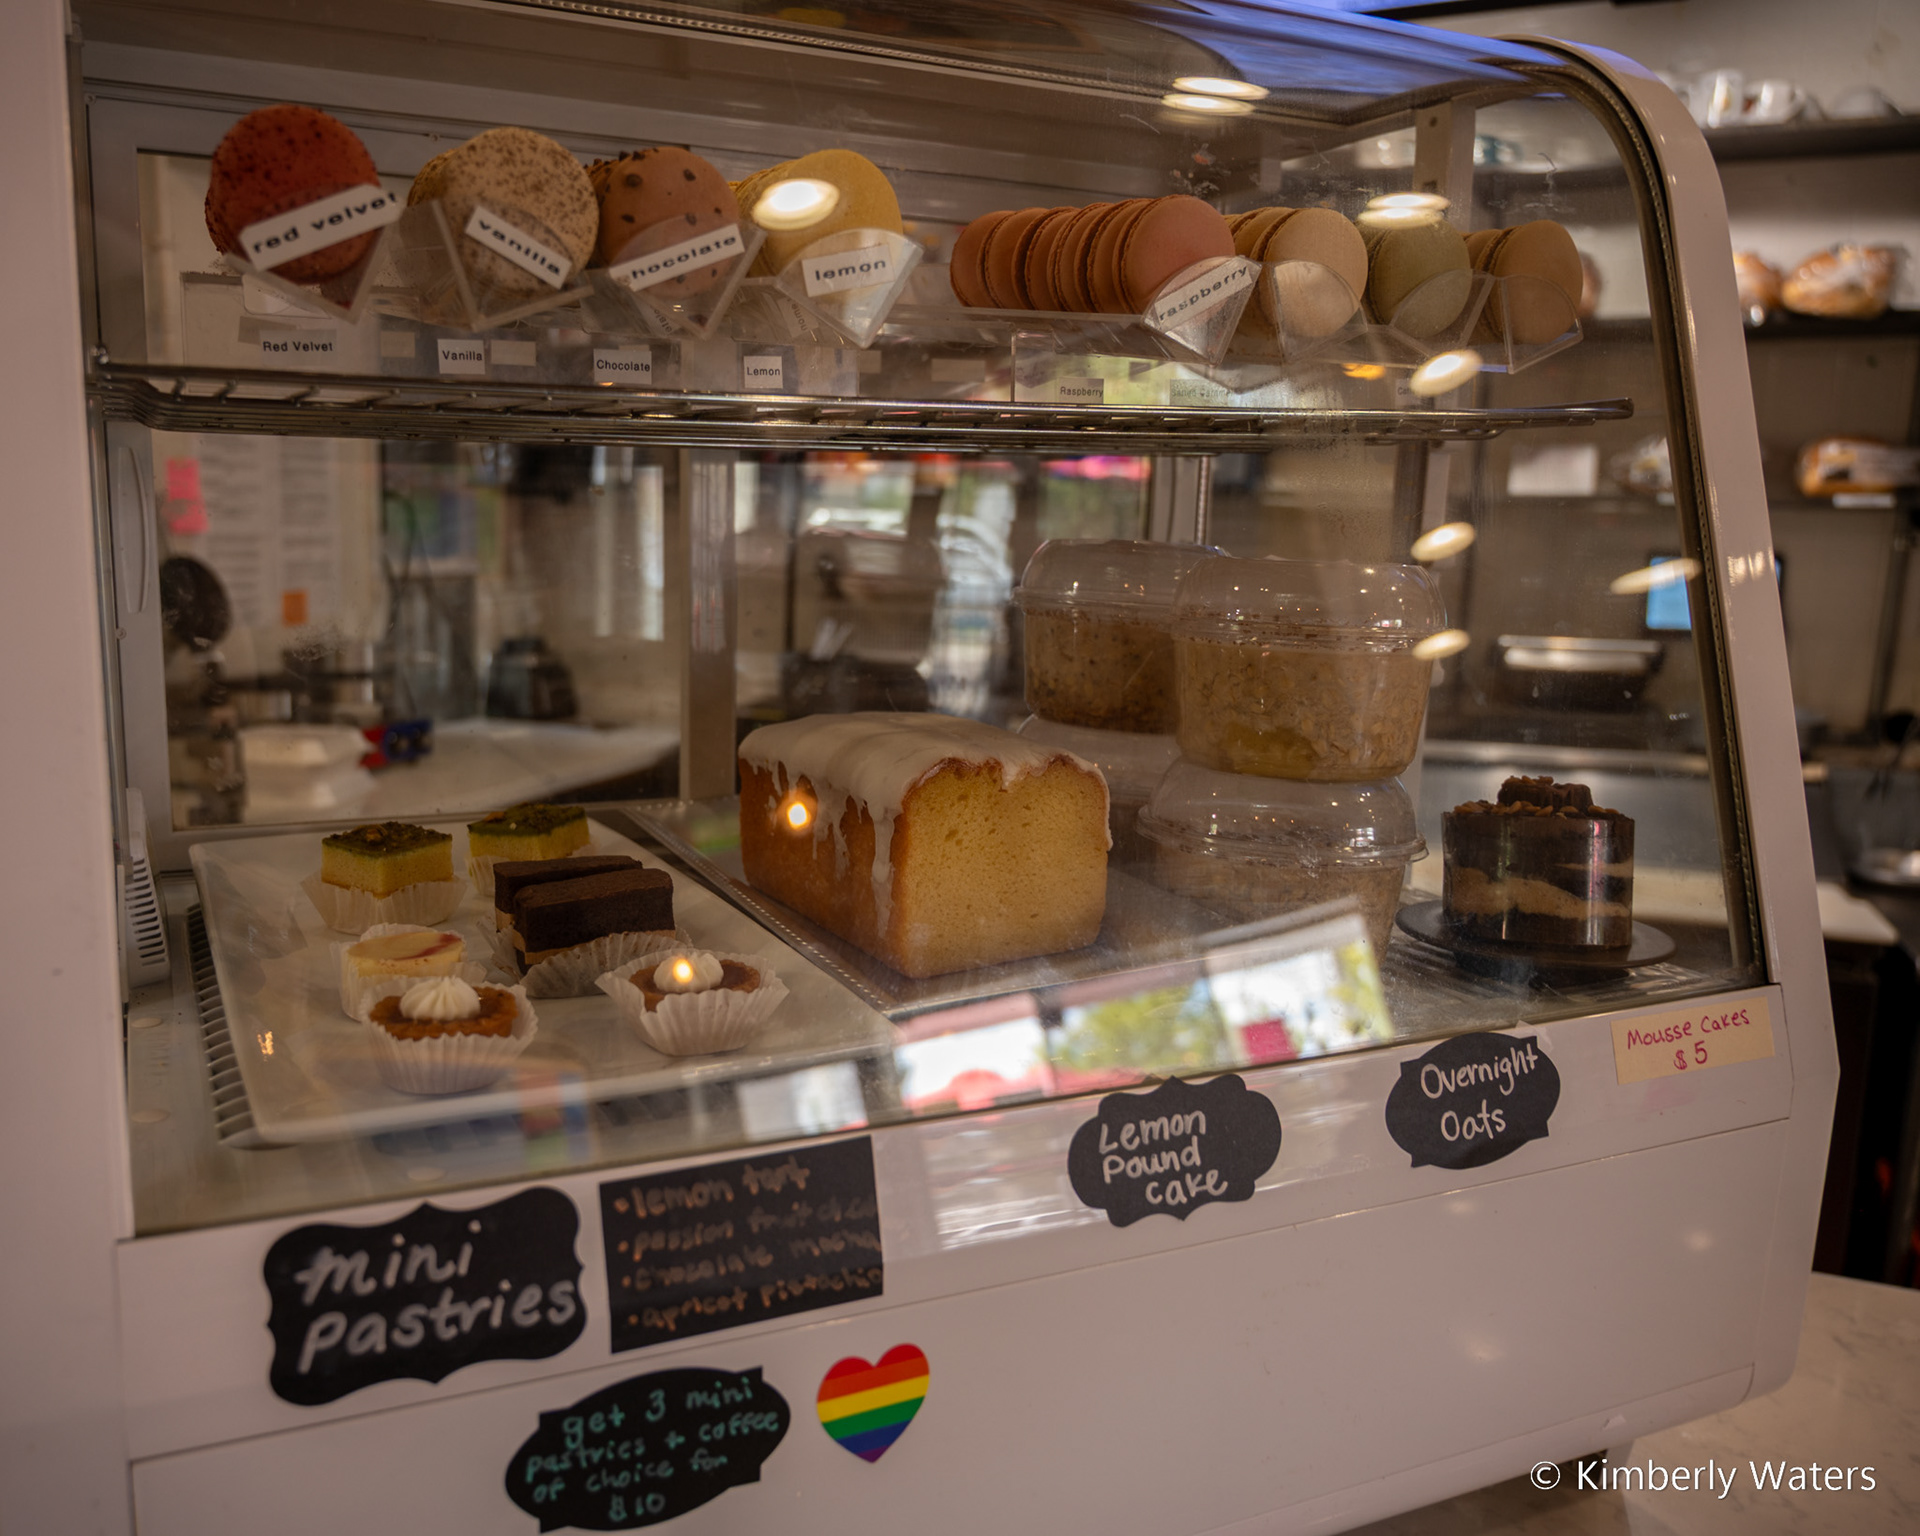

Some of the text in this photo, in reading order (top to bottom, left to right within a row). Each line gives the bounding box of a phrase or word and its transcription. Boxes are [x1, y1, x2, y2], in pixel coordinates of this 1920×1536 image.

[251, 191, 398, 255] red velvet
[479, 220, 560, 274] vanilla
[630, 236, 737, 280] hocolate
[814, 257, 887, 282] lemon
[1159, 265, 1247, 321] raspberry
[262, 340, 334, 352] Red Velvet
[442, 349, 483, 362] Vanilla
[596, 359, 651, 372] Chocolate
[746, 365, 781, 377] Lemon
[1059, 386, 1104, 398] Raspberry
[1626, 1008, 1751, 1050] Mousse Cakes
[1420, 1043, 1538, 1099] Overnight
[1099, 1109, 1207, 1154] Lemon
[1440, 1100, 1506, 1141] Oats
[631, 1179, 734, 1219] lemon
[1144, 1168, 1228, 1206] cake
[294, 1219, 482, 1306] mini
[297, 1279, 577, 1375] pastries
[562, 1376, 753, 1449] get 3 mini
[525, 1436, 646, 1483] pastries
[699, 1410, 779, 1442] coffee
[533, 1476, 565, 1503] of
[586, 1460, 674, 1492] choice
